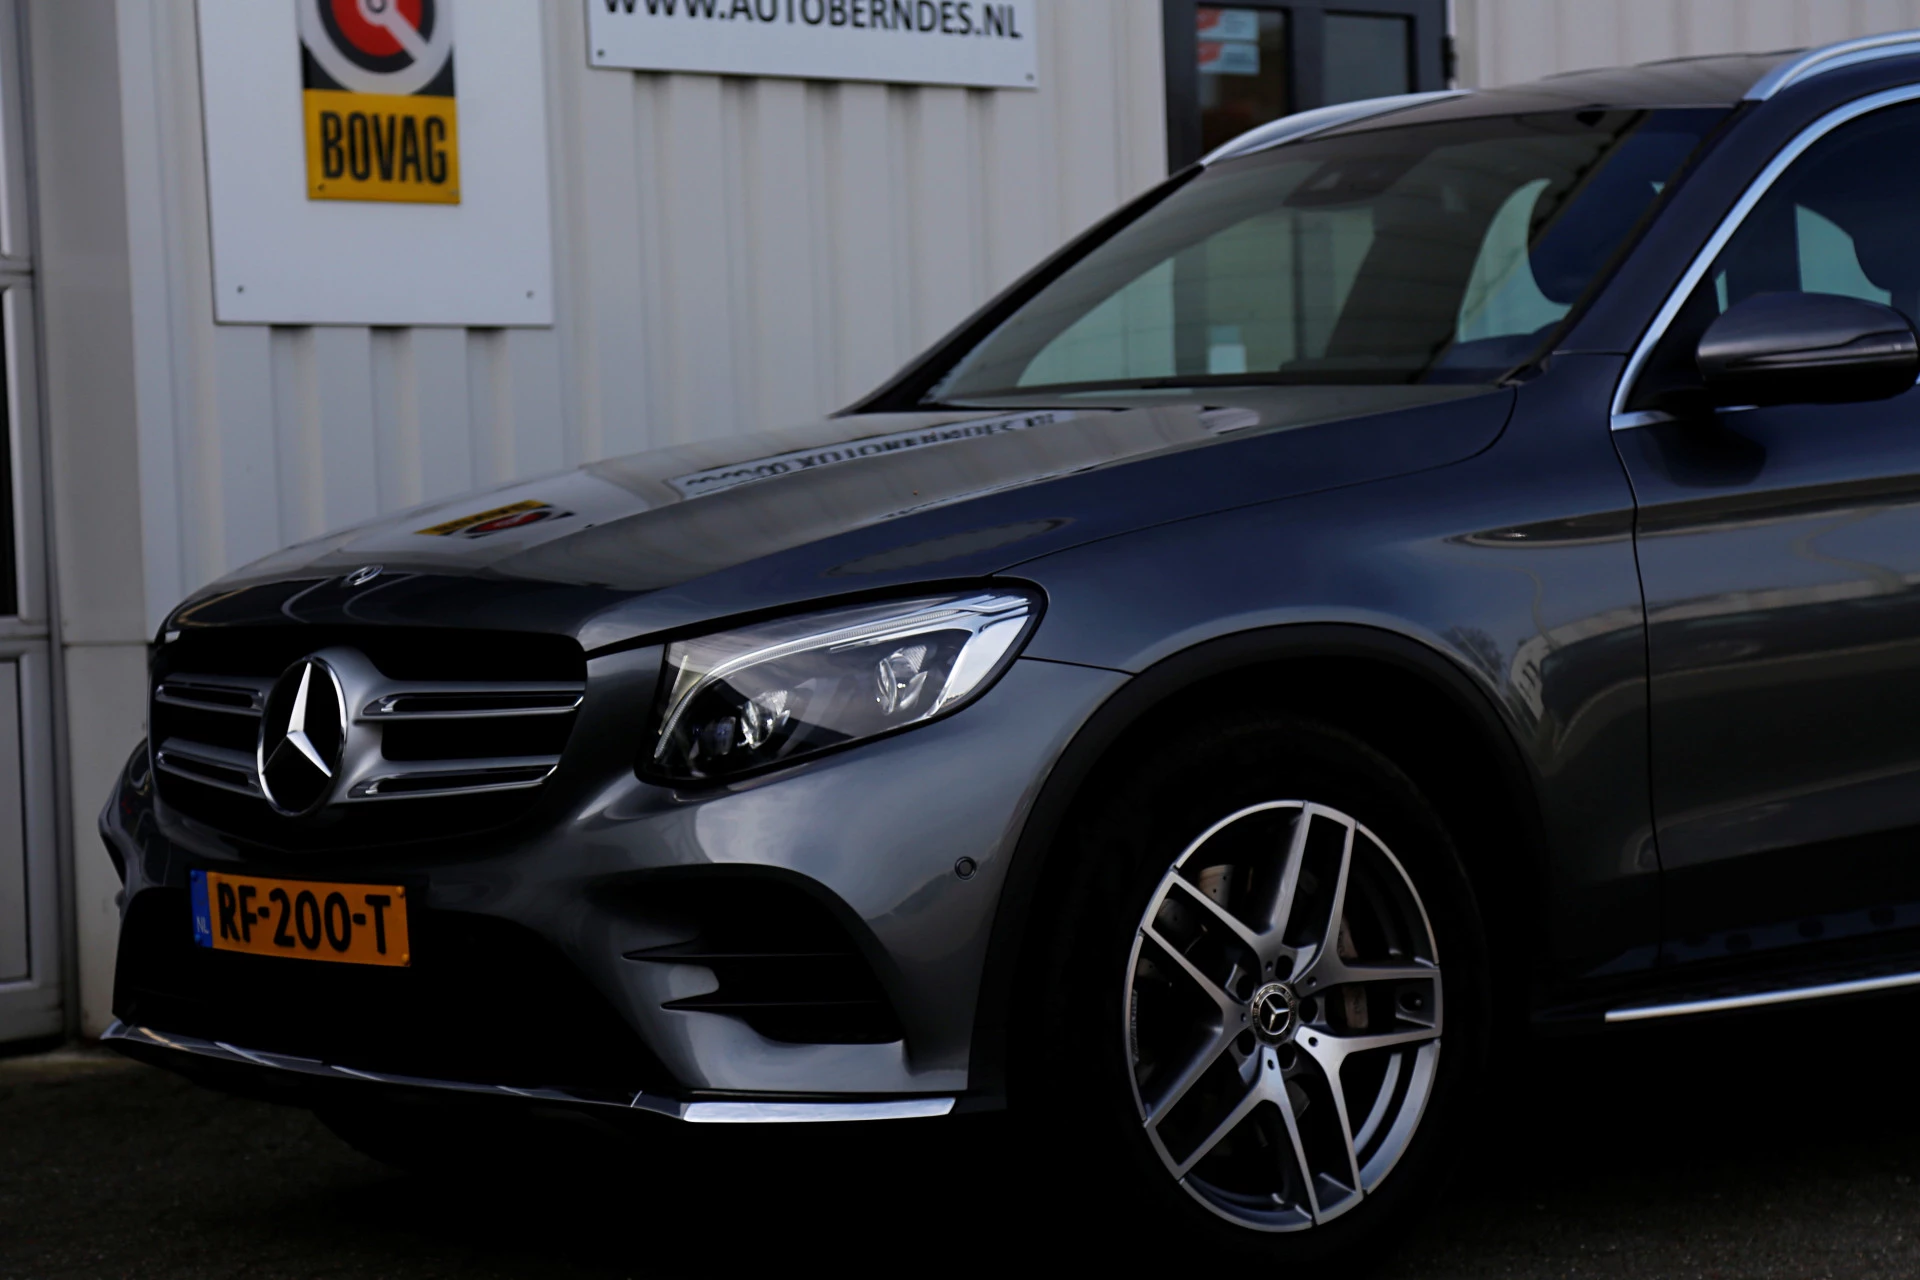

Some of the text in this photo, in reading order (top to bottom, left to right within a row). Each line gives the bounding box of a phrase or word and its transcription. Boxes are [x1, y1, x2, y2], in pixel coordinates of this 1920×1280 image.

[319, 110, 448, 185] BOVAG
[196, 916, 209, 934] NL
[217, 882, 391, 955] RF-200-T
